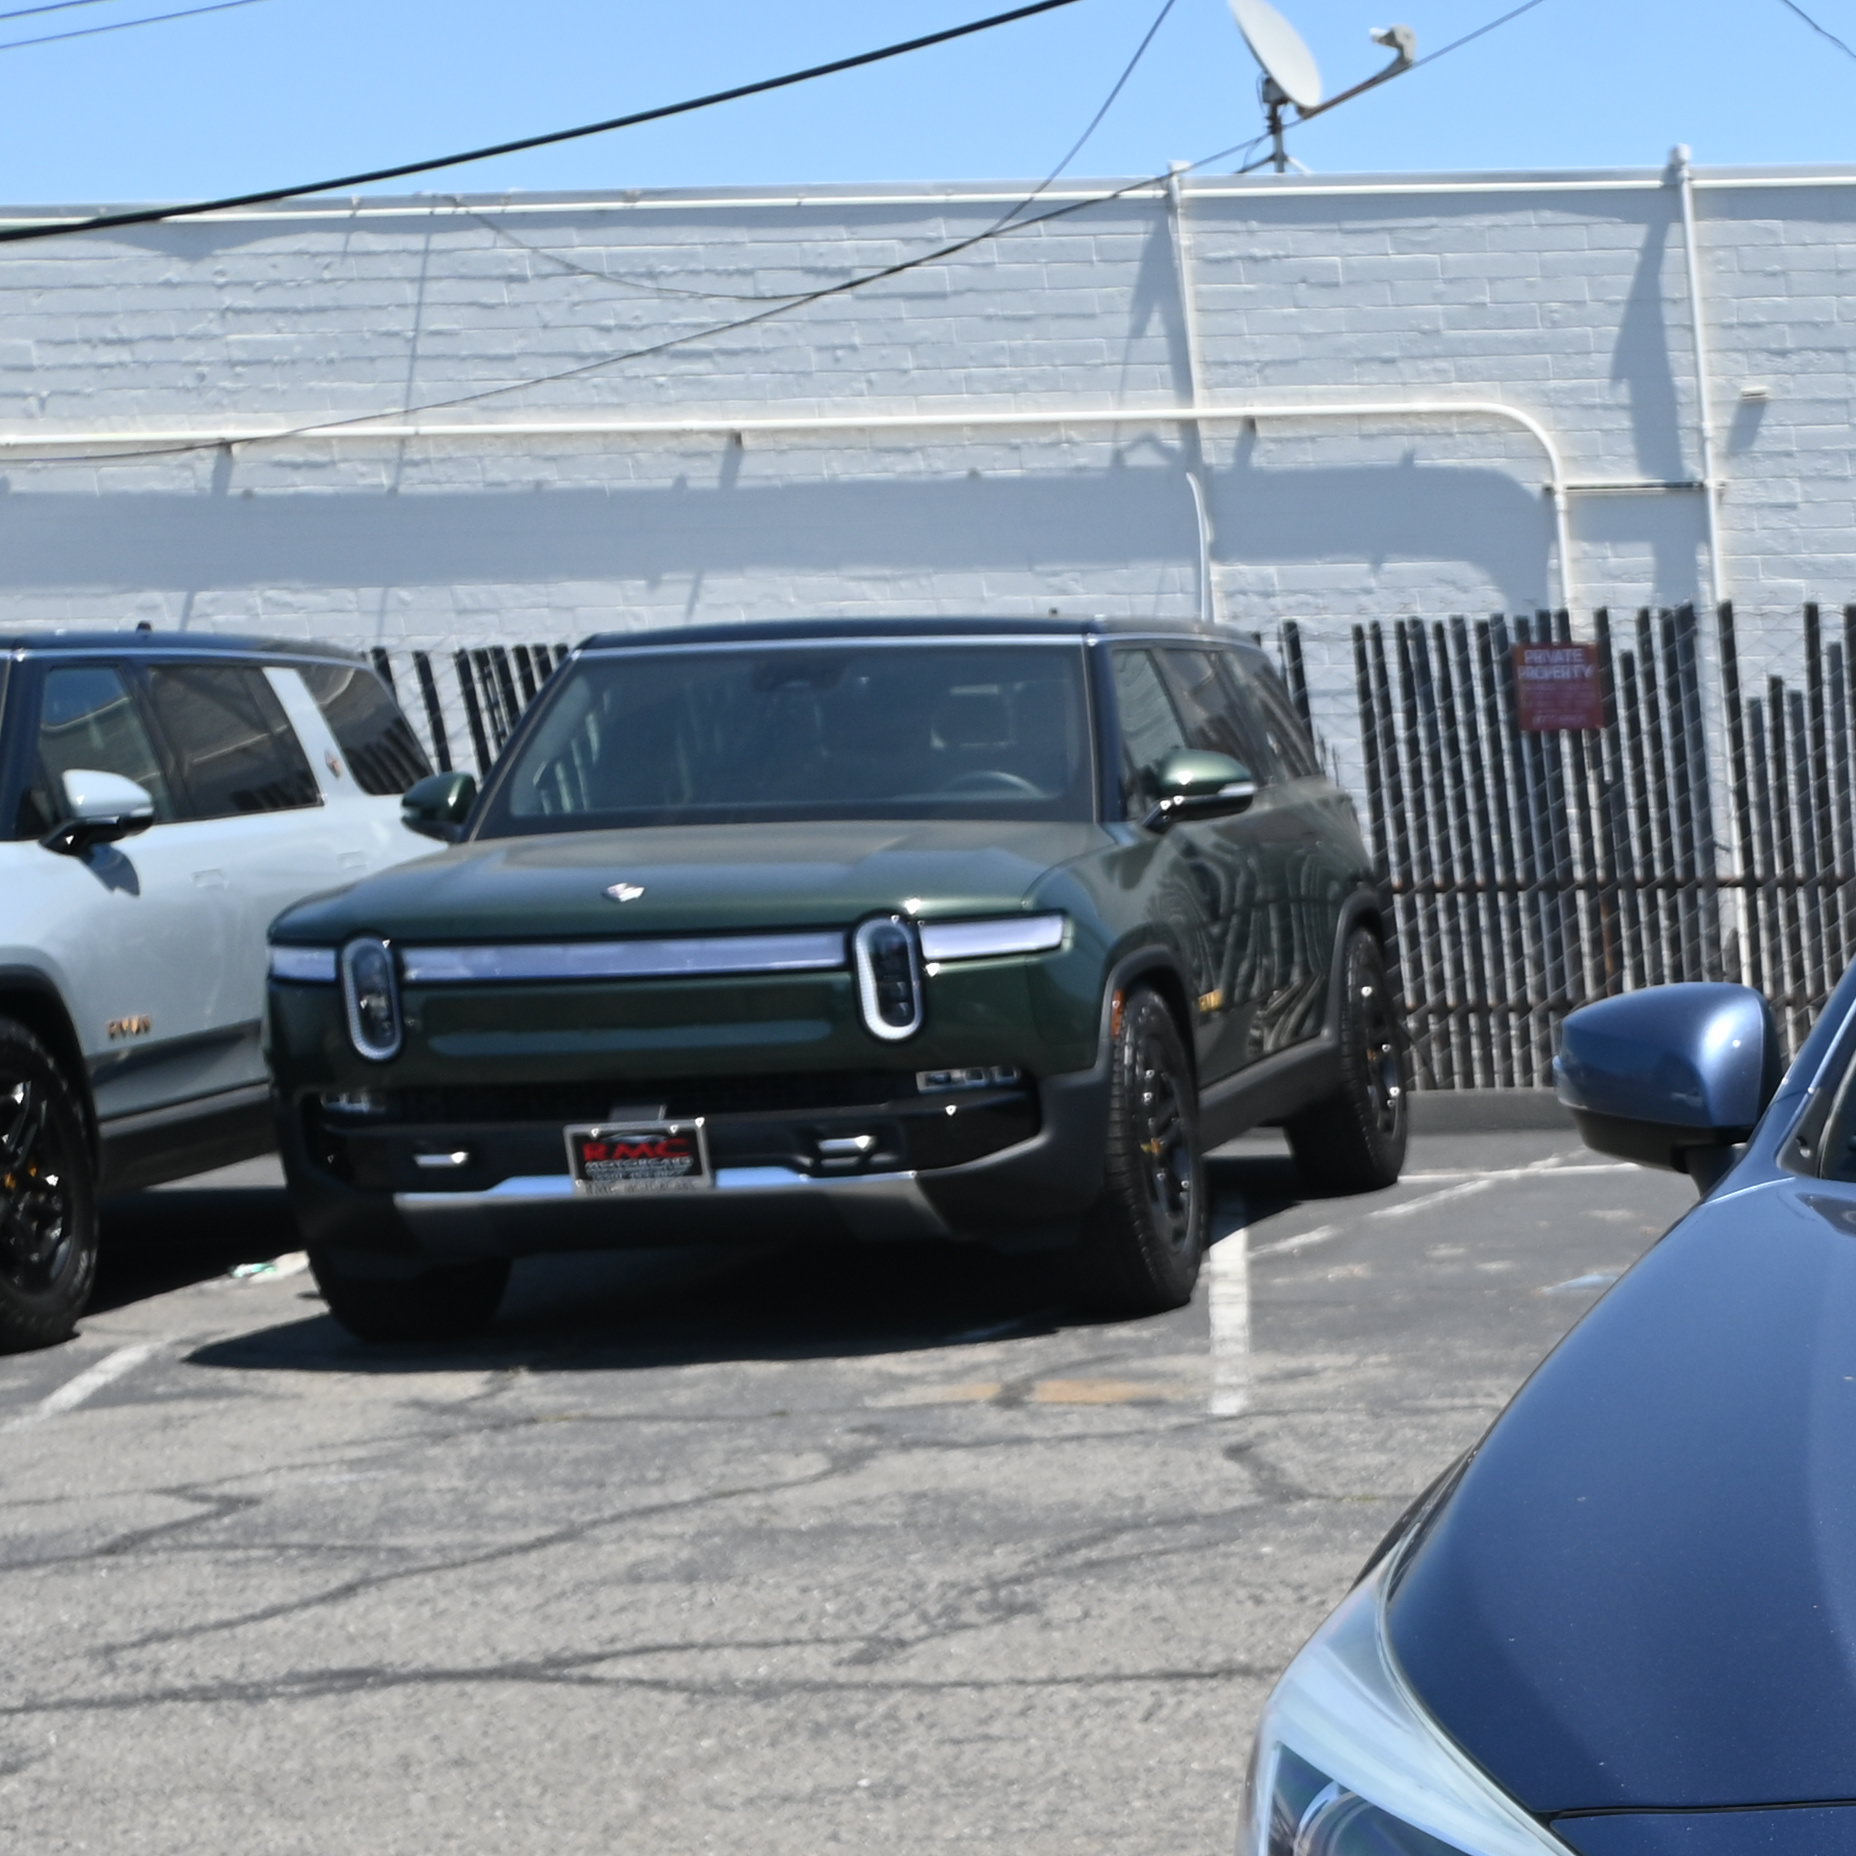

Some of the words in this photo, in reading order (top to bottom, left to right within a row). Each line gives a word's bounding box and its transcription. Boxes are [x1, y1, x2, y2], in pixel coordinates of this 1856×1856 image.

[1524, 648, 1585, 664] PRIVATE
[1517, 664, 1595, 680] PROPERTY
[582, 1138, 690, 1161] RMC
